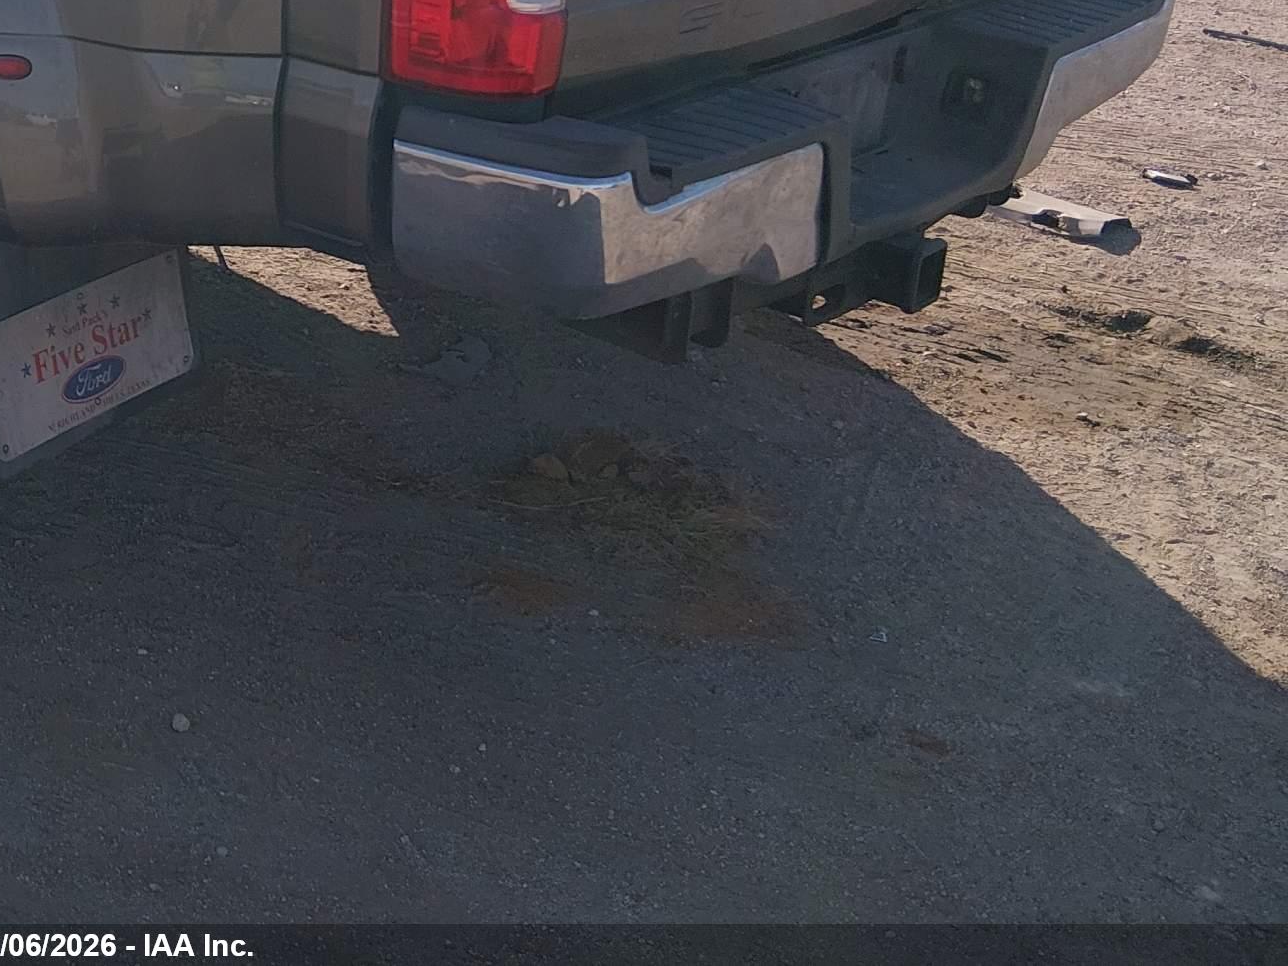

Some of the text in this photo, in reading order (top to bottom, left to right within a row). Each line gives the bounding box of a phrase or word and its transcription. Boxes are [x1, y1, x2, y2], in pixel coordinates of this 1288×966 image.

[32, 317, 143, 384] Five Star
[75, 362, 113, 397] Ford
